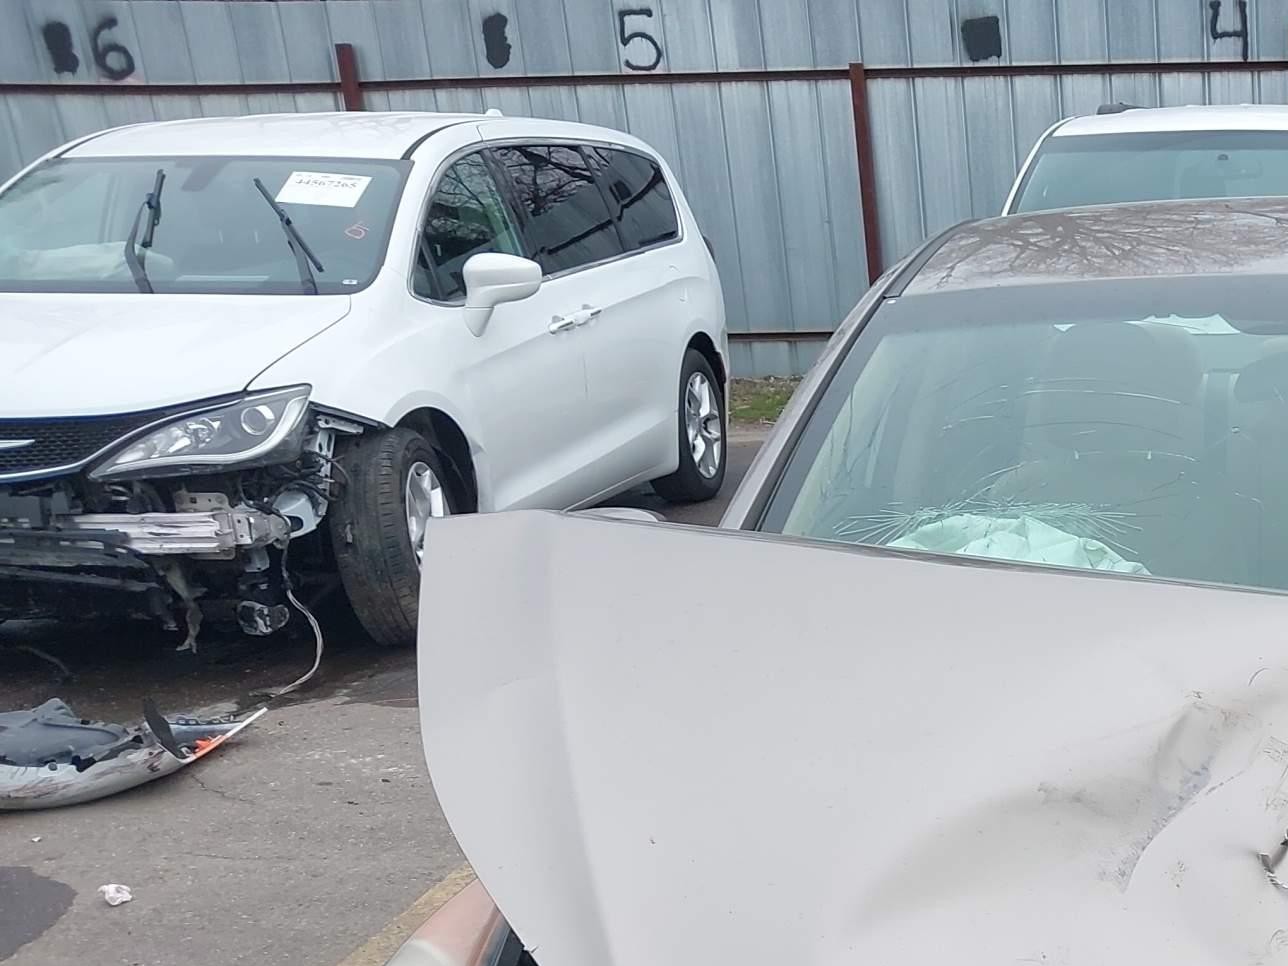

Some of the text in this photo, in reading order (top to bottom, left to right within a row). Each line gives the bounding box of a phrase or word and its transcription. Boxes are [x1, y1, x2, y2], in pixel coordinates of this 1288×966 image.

[92, 16, 135, 80] 6
[618, 8, 662, 70] 5
[1209, 0, 1248, 61] 4
